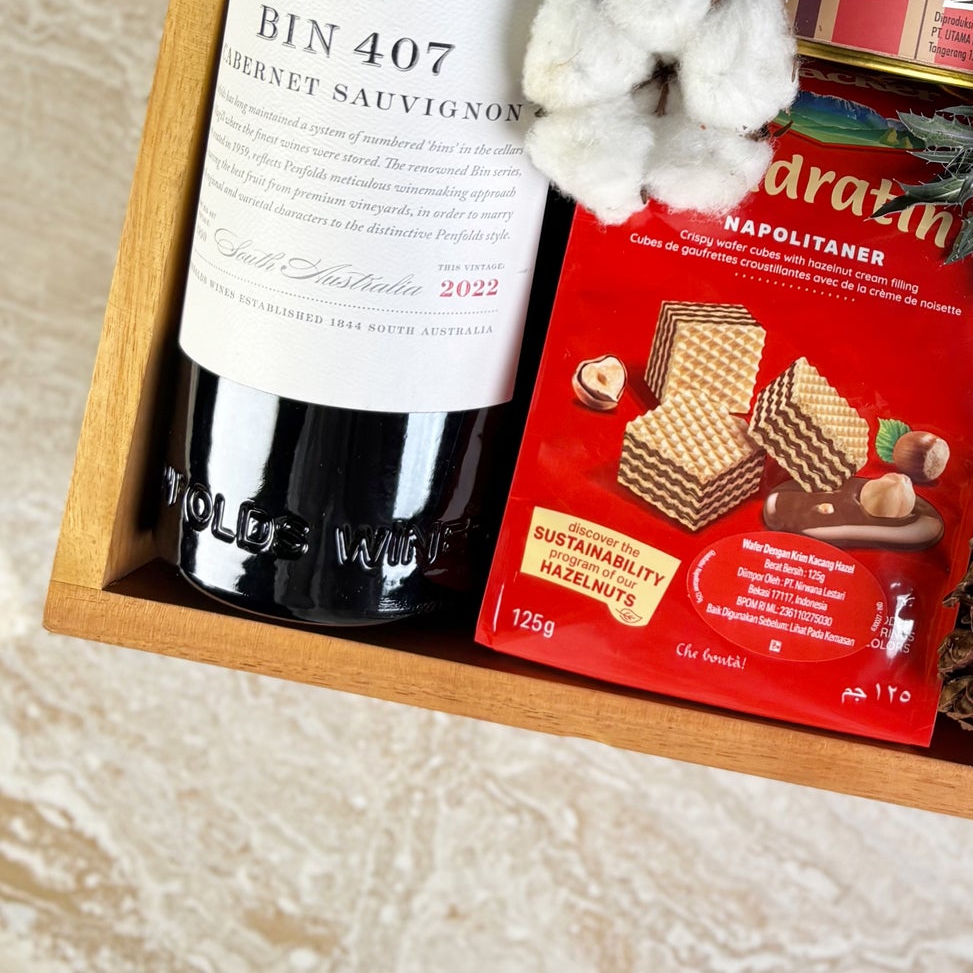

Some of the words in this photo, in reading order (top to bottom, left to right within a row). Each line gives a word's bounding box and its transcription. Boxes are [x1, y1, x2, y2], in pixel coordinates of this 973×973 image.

[256, 3, 341, 58] BIN
[353, 31, 457, 77] 407
[928, 41, 967, 61] Tangerang
[945, 29, 971, 45] UTAMA
[223, 41, 321, 96] CABERNET
[332, 82, 524, 122] SAUVIGNON
[249, 106, 300, 128] maintained
[309, 124, 346, 139] system
[349, 130, 362, 145] of
[363, 135, 426, 151] numbered
[460, 145, 472, 154] in
[474, 145, 491, 155] the
[493, 144, 524, 155] cellars
[253, 127, 278, 145] finest
[280, 140, 310, 153] wines
[312, 147, 341, 160] were
[385, 157, 407, 170] The
[408, 163, 470, 176] renowned
[471, 165, 490, 176] Bin
[245, 170, 266, 187] fruit
[265, 178, 292, 194] from
[291, 188, 346, 207] premium
[416, 206, 430, 218] in
[433, 208, 465, 220] order
[467, 210, 479, 220] to
[480, 210, 514, 223] marry
[252, 152, 283, 170] reflects
[284, 159, 327, 181] Penfolds
[330, 174, 391, 191] meticulous
[394, 184, 469, 202] winemaking
[470, 187, 517, 203] approach
[238, 193, 273, 212] varietal
[274, 205, 328, 226] characters
[330, 217, 342, 228] to
[344, 219, 365, 233] the
[366, 222, 433, 240] distinctive
[435, 228, 484, 245] Penfolds
[723, 215, 885, 266] NAPOLITANER
[214, 227, 286, 271] South
[280, 257, 424, 297] Australia
[629, 232, 663, 250] Cubes
[664, 238, 679, 253] de
[681, 243, 738, 265] gaufrettes
[739, 256, 811, 281] croustillantes
[813, 272, 838, 286] avec
[840, 275, 854, 291] de
[856, 279, 867, 294] la
[868, 285, 902, 304] crème
[904, 290, 918, 305] de
[920, 295, 962, 316] noisette
[679, 228, 715, 249] Crispy
[716, 235, 748, 254] wafer
[749, 244, 781, 261] cubes
[783, 250, 806, 267] with
[808, 256, 853, 278] hazelnut
[854, 269, 888, 286] cream
[890, 275, 919, 295] filling
[439, 277, 499, 298] 2022
[238, 293, 323, 325] ESTABLISHED
[330, 317, 362, 331] 1844
[367, 323, 415, 336] SOUTH
[420, 325, 493, 337] AUSTRALIA
[533, 525, 666, 587] SUSTAINABILITY
[567, 520, 620, 548] discover
[621, 541, 641, 559] the
[741, 538, 764, 556] Wafer
[763, 543, 791, 560] Dengan
[791, 549, 808, 564] Krim
[808, 553, 835, 572] Kacang
[835, 559, 856, 575] Hazel
[539, 559, 637, 608] HAZELNUTS
[549, 547, 600, 576] program
[601, 565, 616, 580] of
[616, 573, 638, 590] our
[763, 558, 783, 573] Berat
[807, 567, 826, 583] 125g
[722, 606, 759, 624] Digunakan
[736, 595, 757, 610] BPOM
[747, 583, 771, 600] Bekasi
[794, 594, 828, 612] Indonesia
[823, 585, 846, 601] Lestari
[511, 607, 556, 639] 125g
[675, 642, 699, 660] Che
